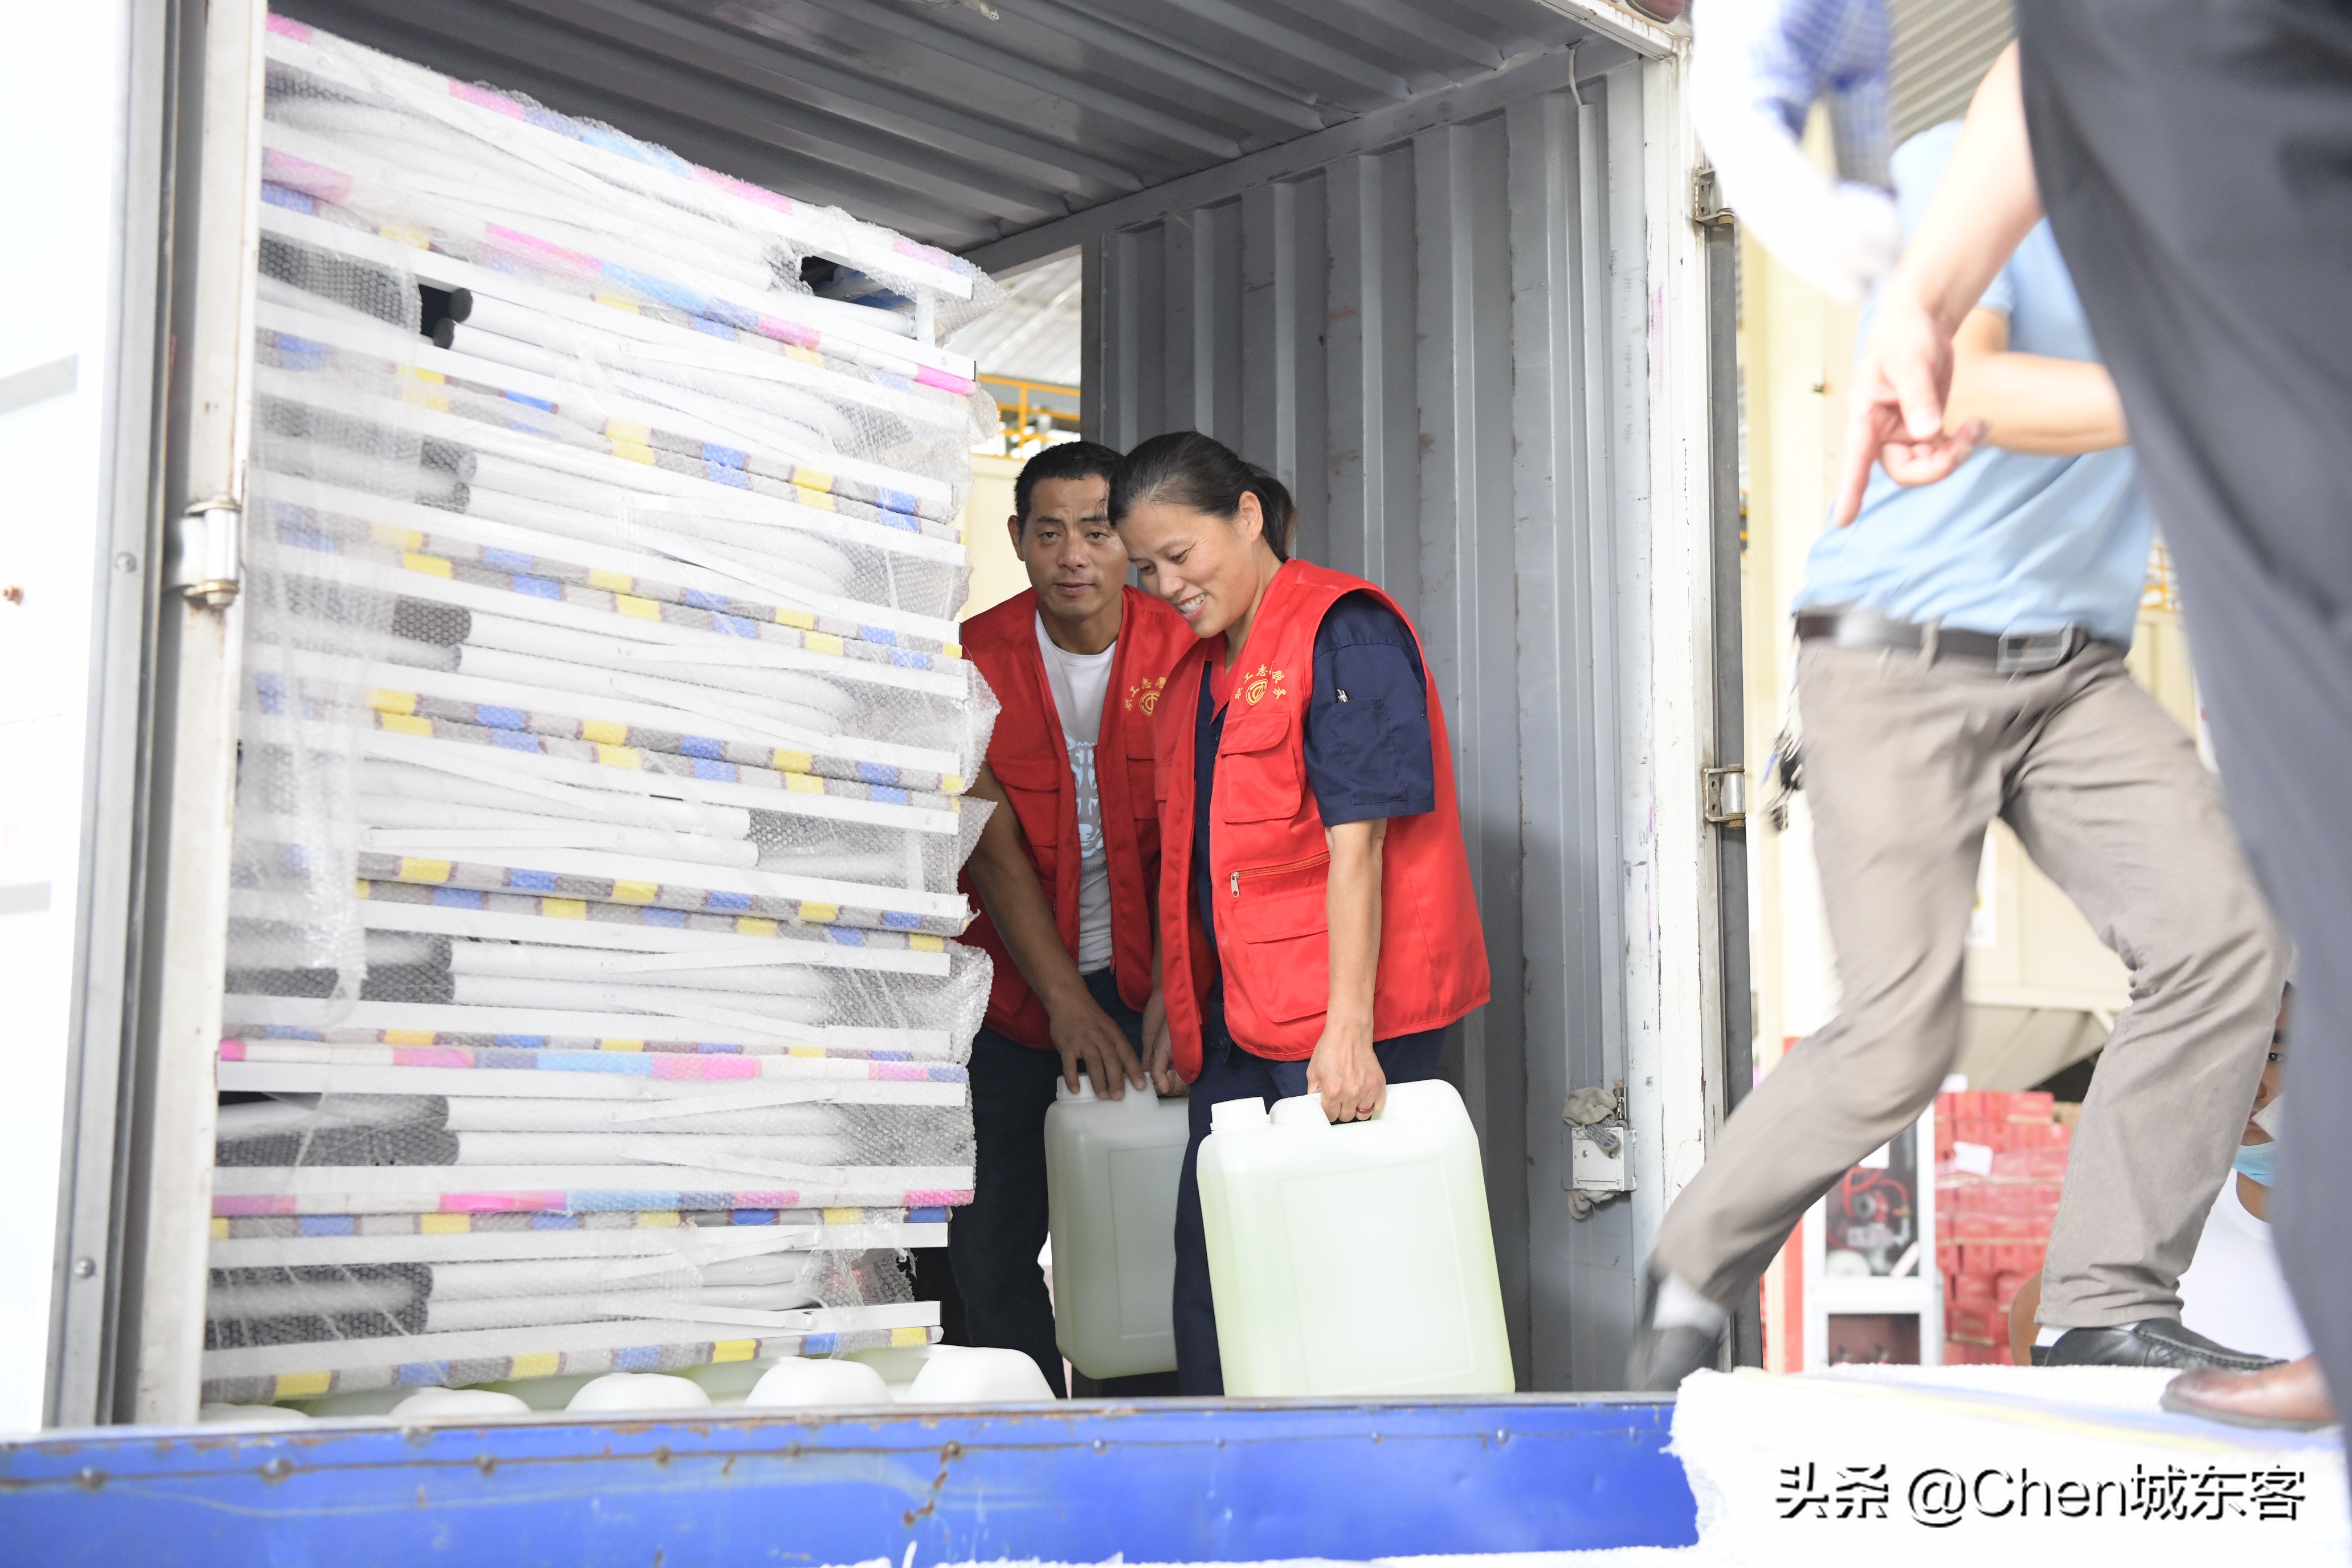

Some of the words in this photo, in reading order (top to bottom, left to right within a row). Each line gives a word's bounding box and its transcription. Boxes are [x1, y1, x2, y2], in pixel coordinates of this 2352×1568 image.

[1234, 662, 1287, 700] 职工志服务
